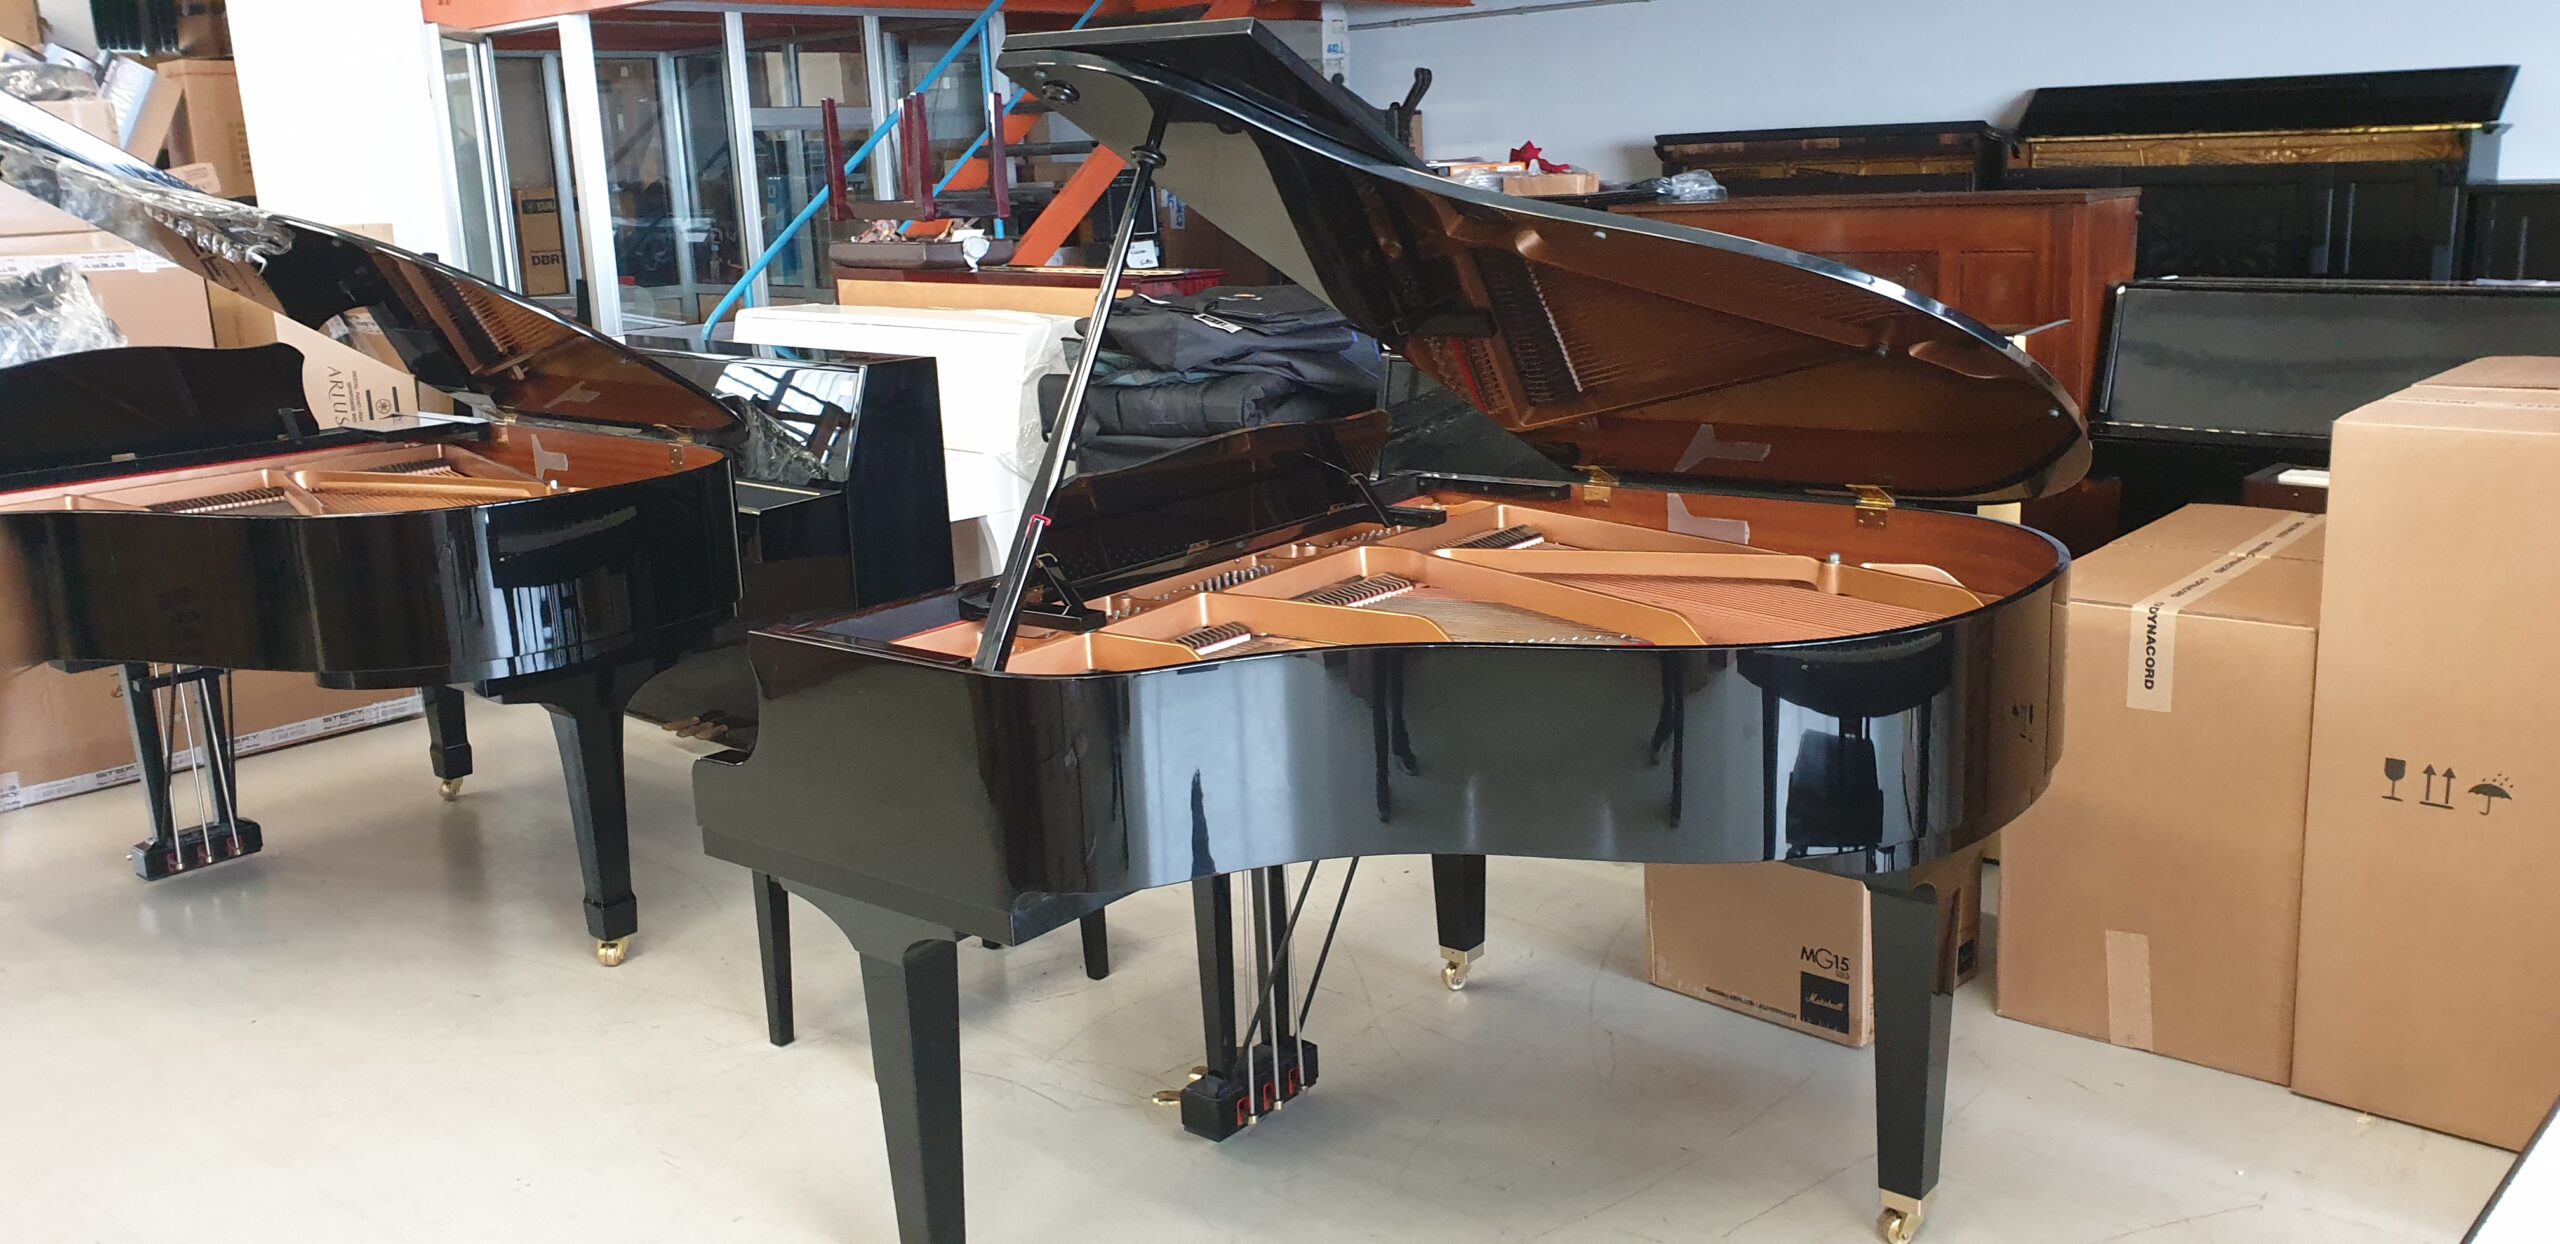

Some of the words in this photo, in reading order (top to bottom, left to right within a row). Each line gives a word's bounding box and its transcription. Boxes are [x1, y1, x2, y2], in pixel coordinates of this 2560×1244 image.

[327, 366, 350, 426] ARIUS
[2144, 606, 2160, 690] DYNACORD
[1800, 946, 1850, 972] MG15
